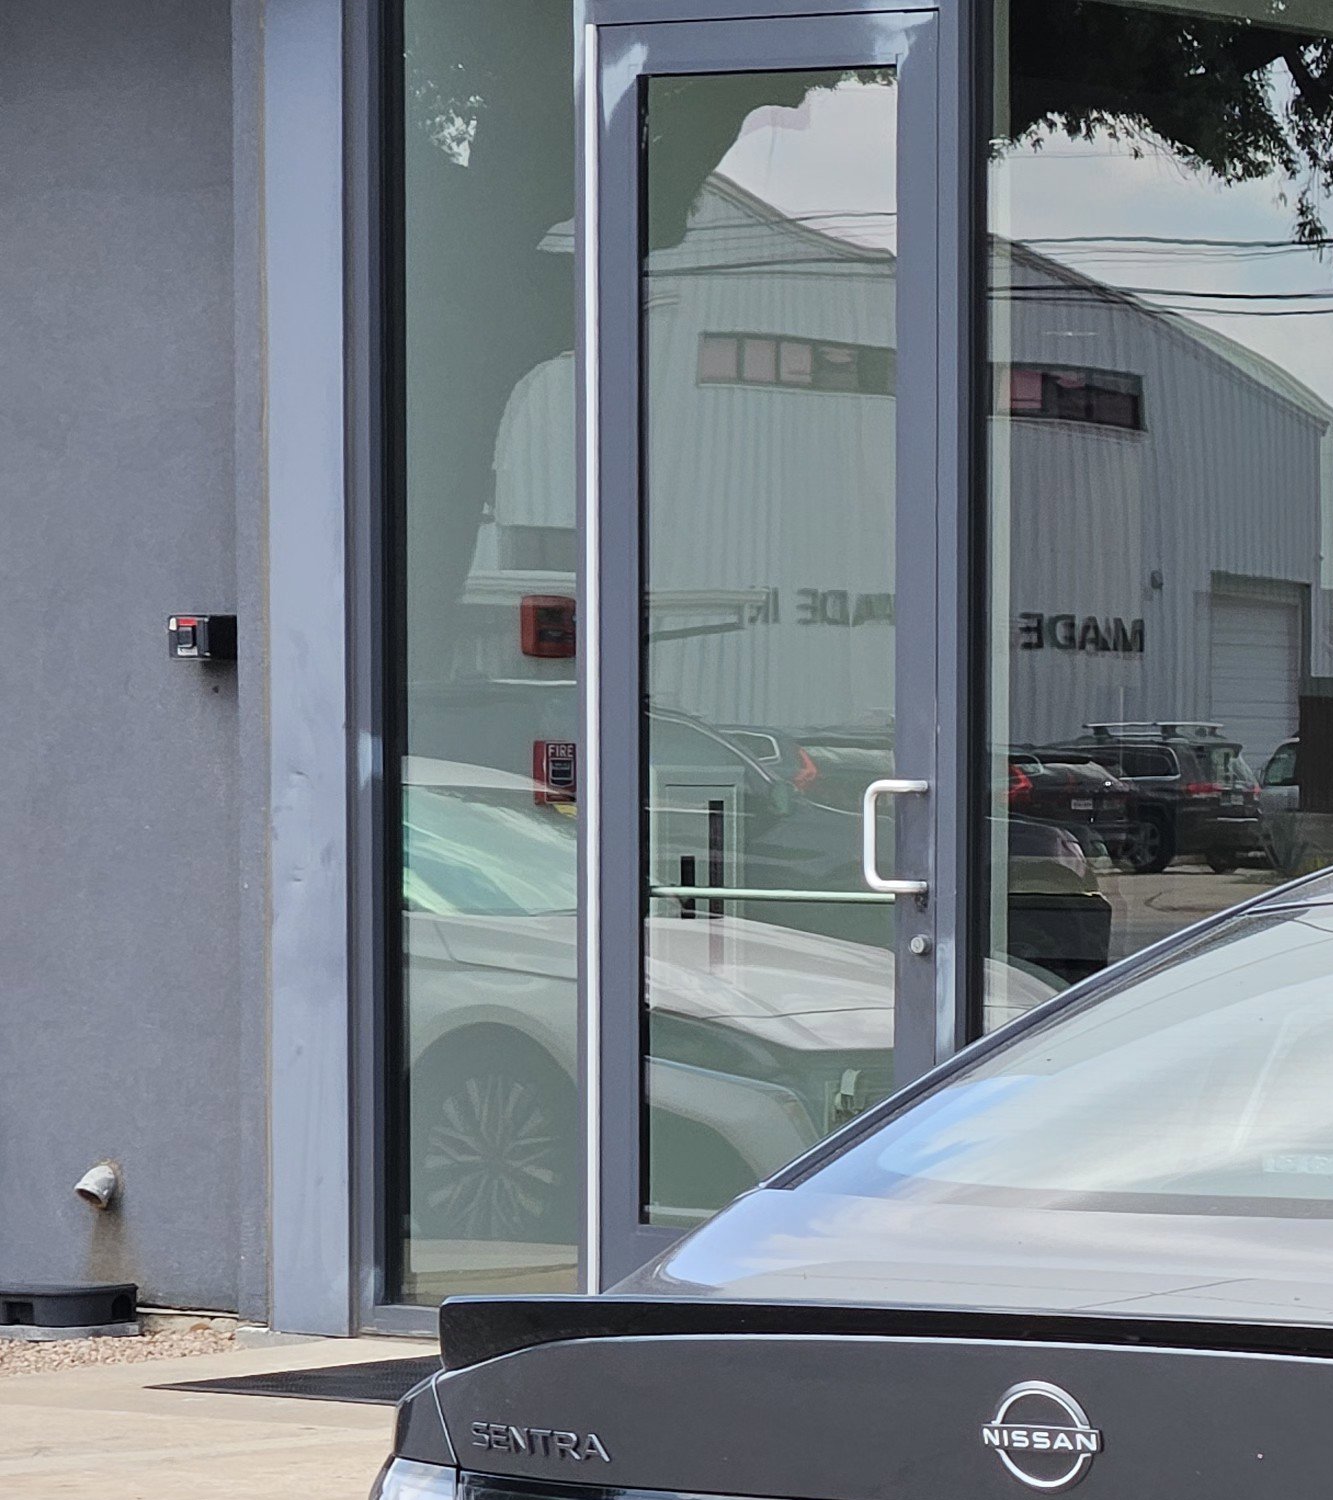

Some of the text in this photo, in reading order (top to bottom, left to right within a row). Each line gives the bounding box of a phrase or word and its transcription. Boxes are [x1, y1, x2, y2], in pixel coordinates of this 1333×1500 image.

[547, 744, 574, 758] FIRE
[471, 1421, 612, 1463] SENTRA
[982, 1427, 1097, 1452] NISSAN
